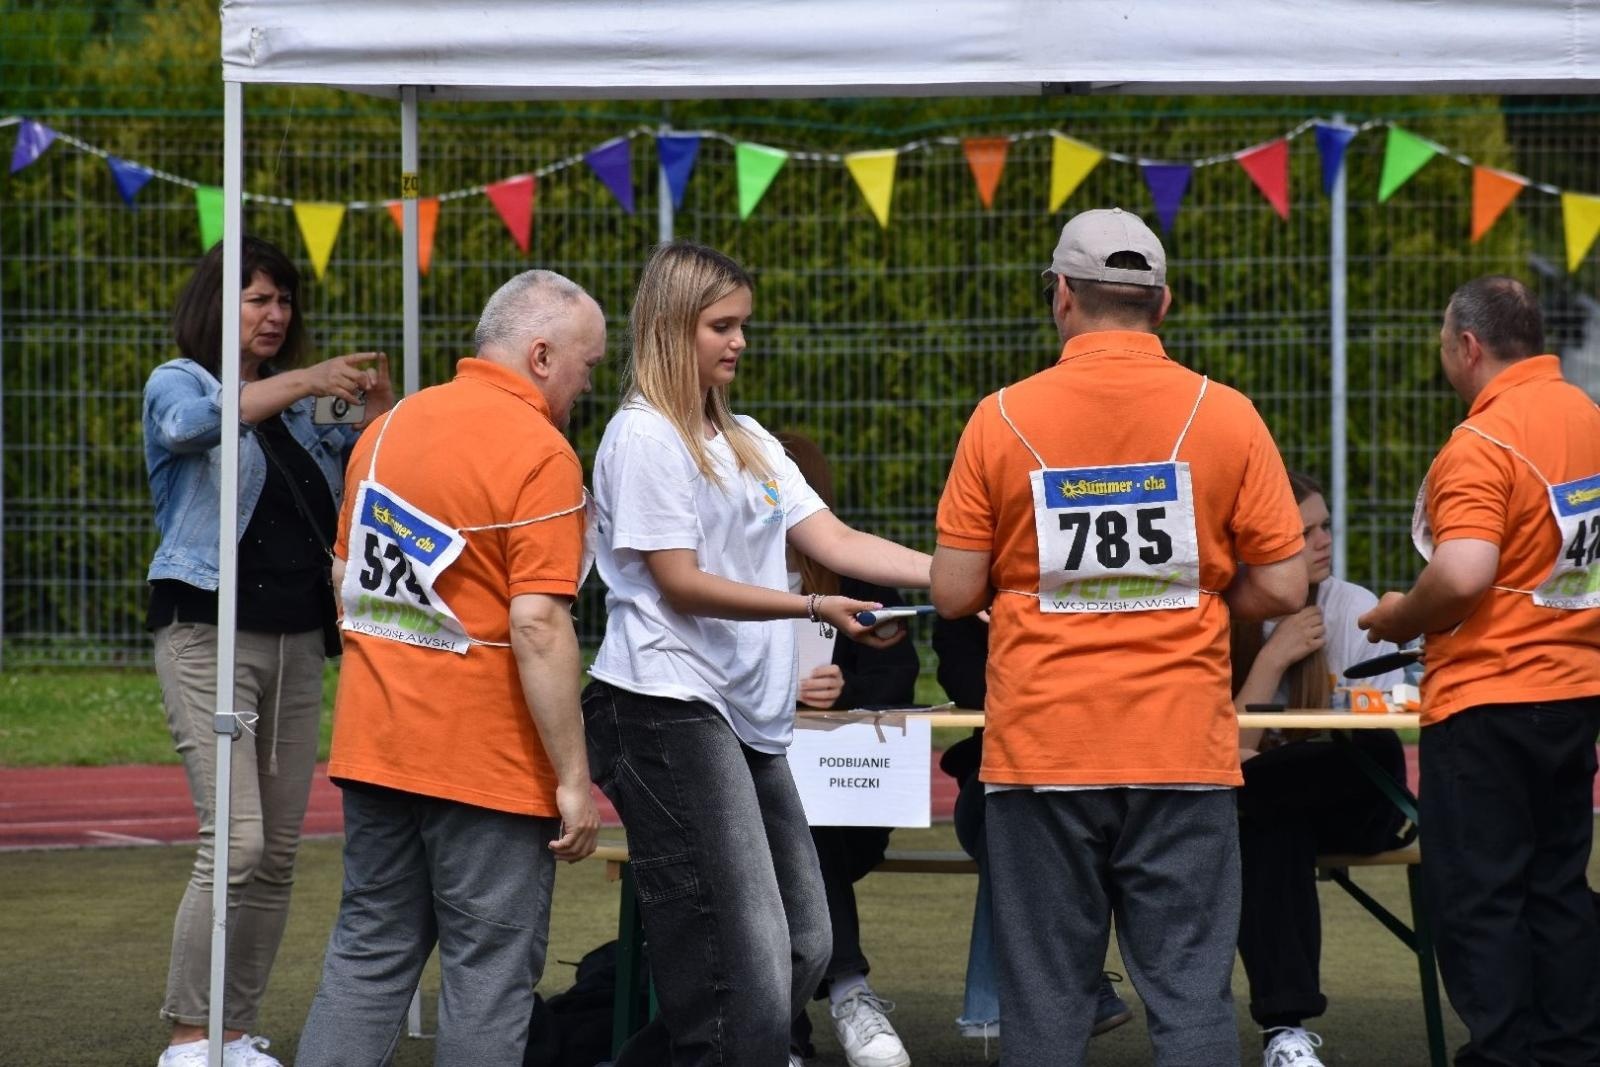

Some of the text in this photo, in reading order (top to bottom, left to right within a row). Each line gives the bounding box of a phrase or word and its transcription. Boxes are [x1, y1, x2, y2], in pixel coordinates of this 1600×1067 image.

[1077, 476, 1167, 495] Summer cha
[1058, 506, 1173, 570] 785
[1052, 597, 1187, 611] WODZISŁAWSKI
[351, 620, 456, 650] WODZISŁAWSKI
[819, 756, 891, 769] PODBIJANIE
[829, 777, 880, 788] PIŁECZKI
